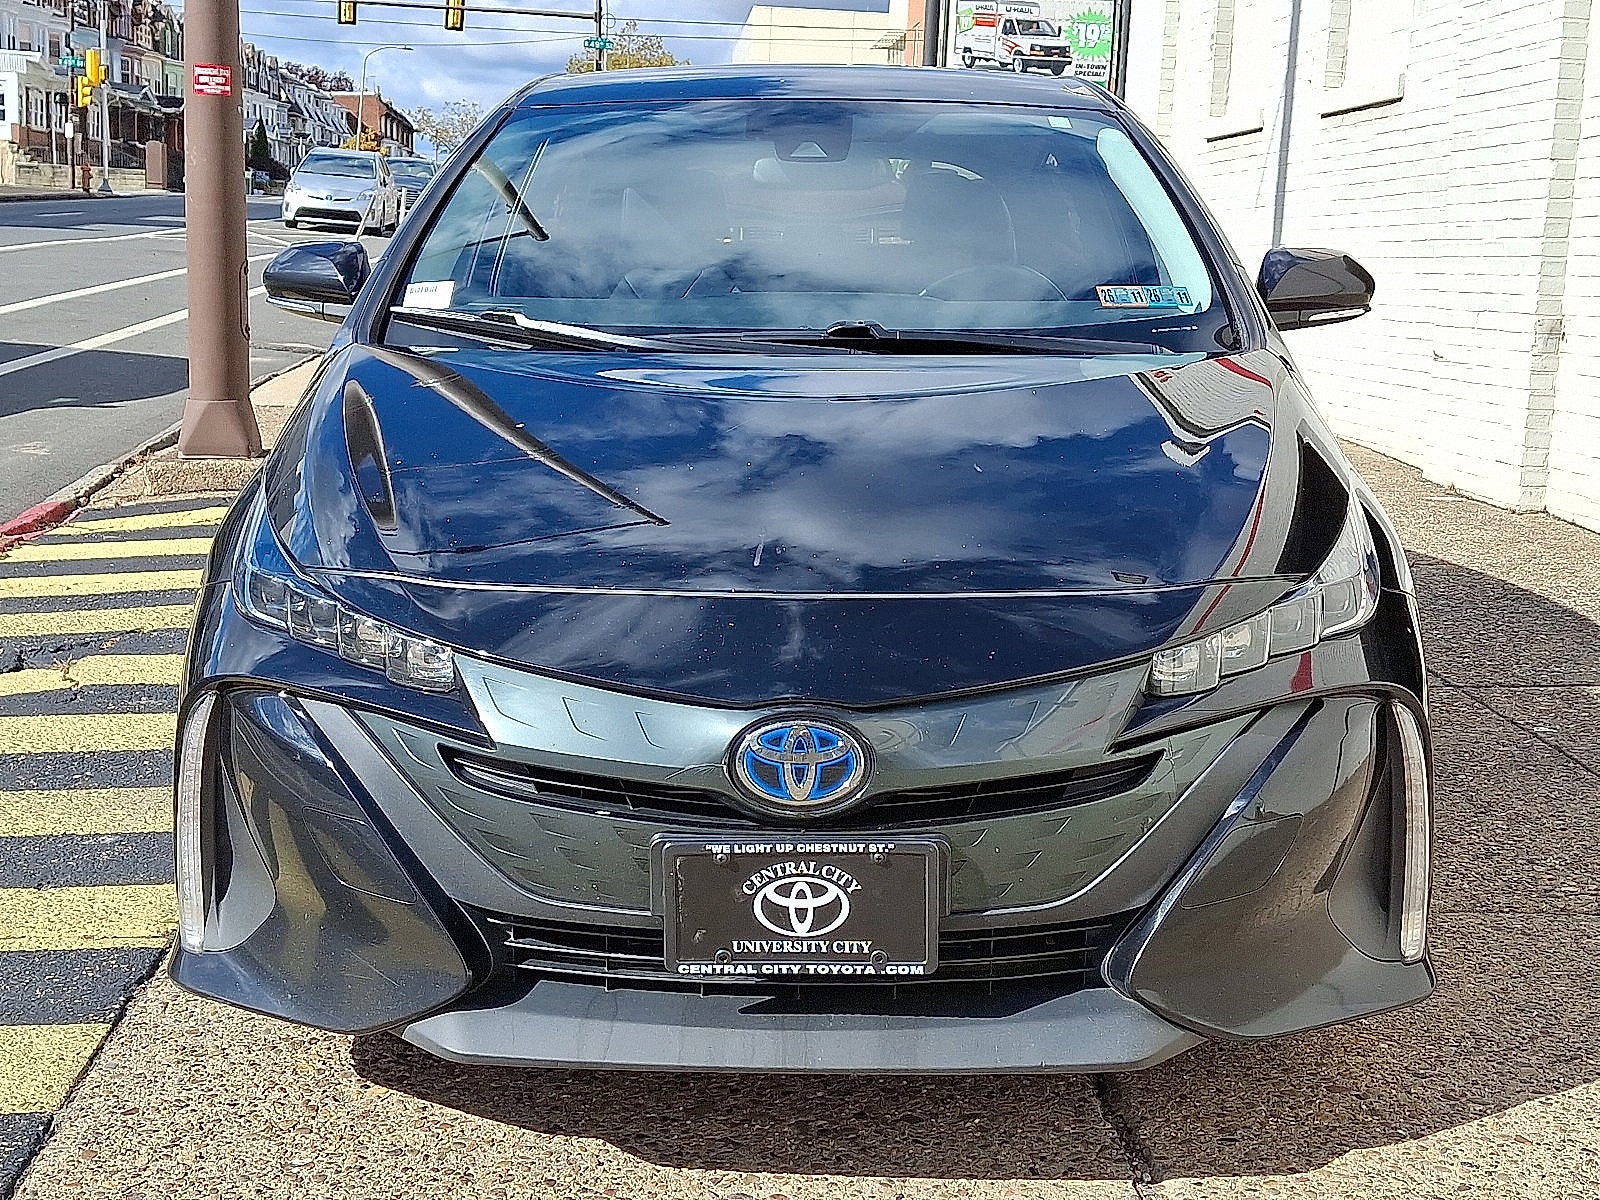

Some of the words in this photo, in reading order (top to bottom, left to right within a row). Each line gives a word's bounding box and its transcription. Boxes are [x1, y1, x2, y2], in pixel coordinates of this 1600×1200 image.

[1100, 289, 1115, 303] 26
[1130, 290, 1144, 303] 11
[1146, 288, 1161, 303] 26
[734, 844, 773, 853] LIGHT
[776, 844, 793, 852] UP
[799, 844, 867, 853] CHESTNUT
[742, 861, 821, 895] CENTRAL
[821, 865, 863, 894] CITY
[732, 940, 830, 954] UNIVERSITY
[832, 940, 873, 954] CITY
[677, 964, 758, 975] CENTRAL
[761, 964, 802, 975] CITY
[806, 964, 875, 975] TOYOTA
